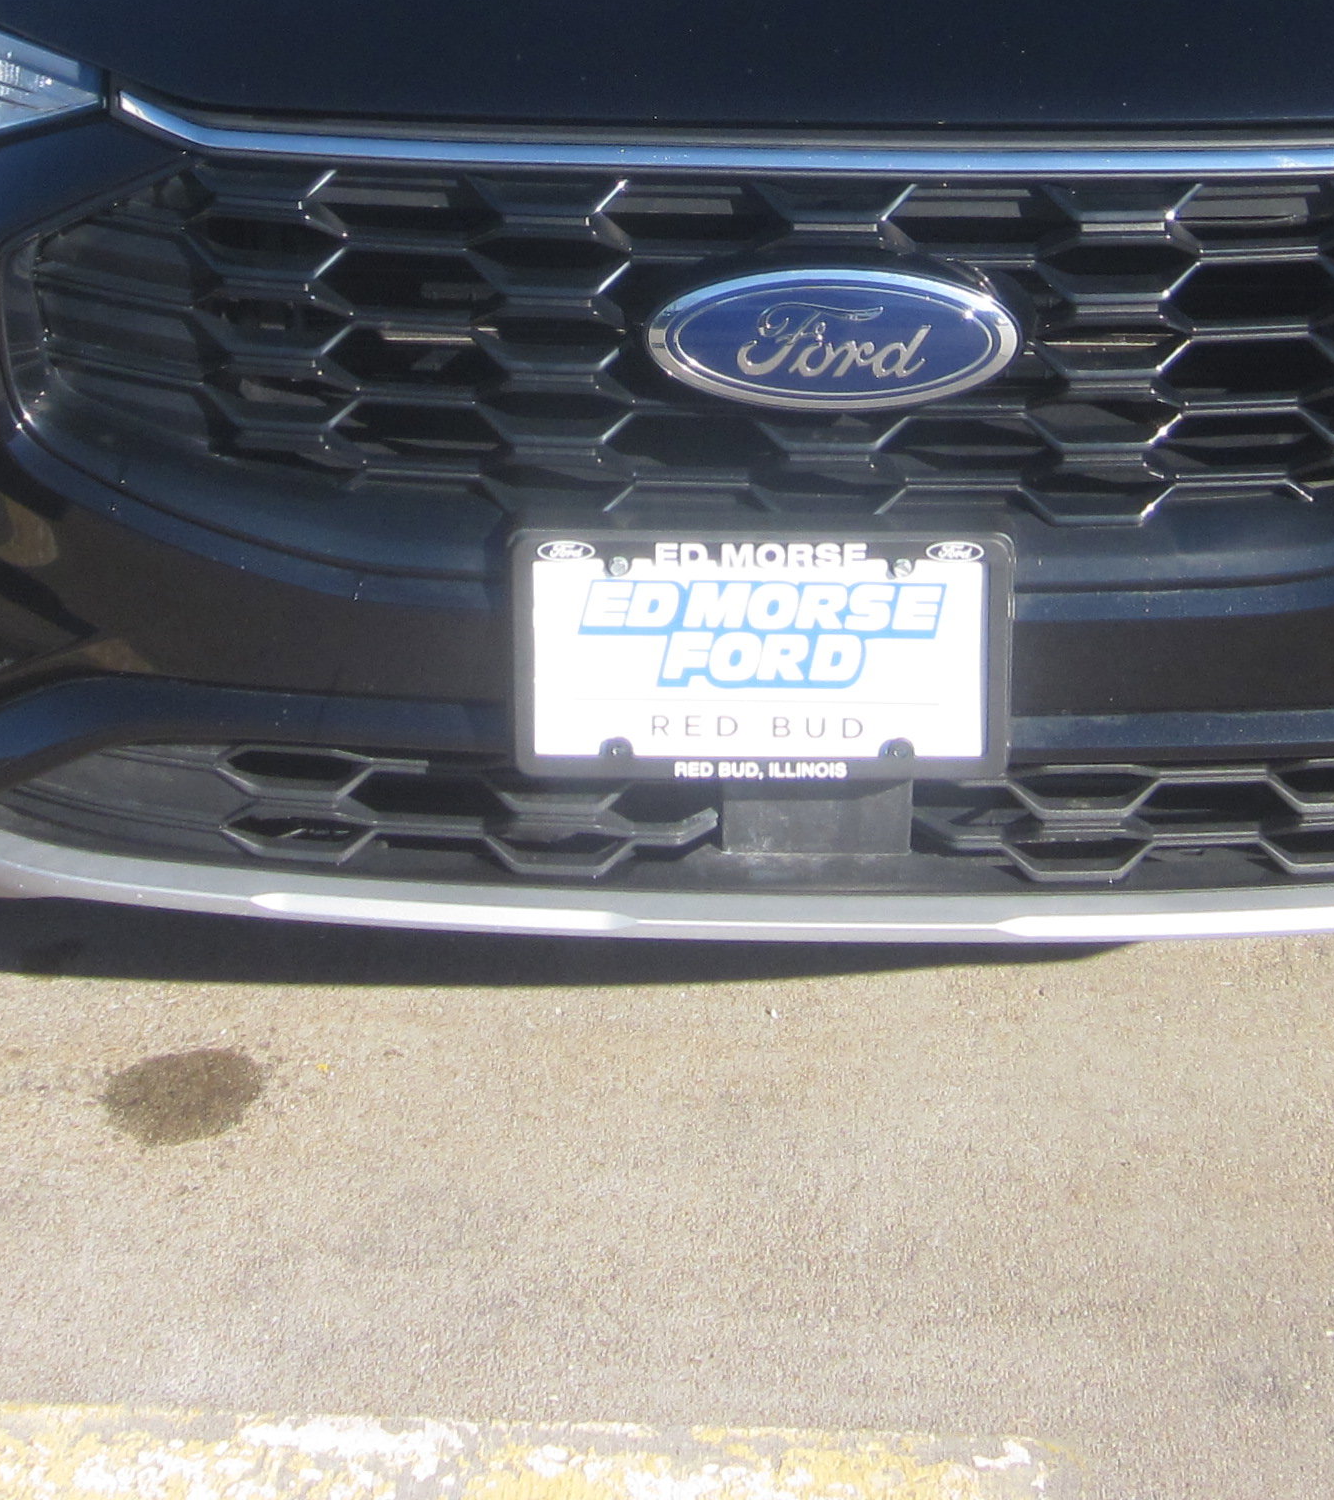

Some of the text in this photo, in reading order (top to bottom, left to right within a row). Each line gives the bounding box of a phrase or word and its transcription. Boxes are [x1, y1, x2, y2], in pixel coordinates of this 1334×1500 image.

[736, 302, 932, 379] Ford
[655, 542, 868, 568] ED MORSE
[578, 579, 948, 639] ED MORSE
[656, 630, 867, 689] FORD
[651, 715, 864, 739] RED BUD
[674, 761, 848, 780] RED BUD, ILLINOIS
